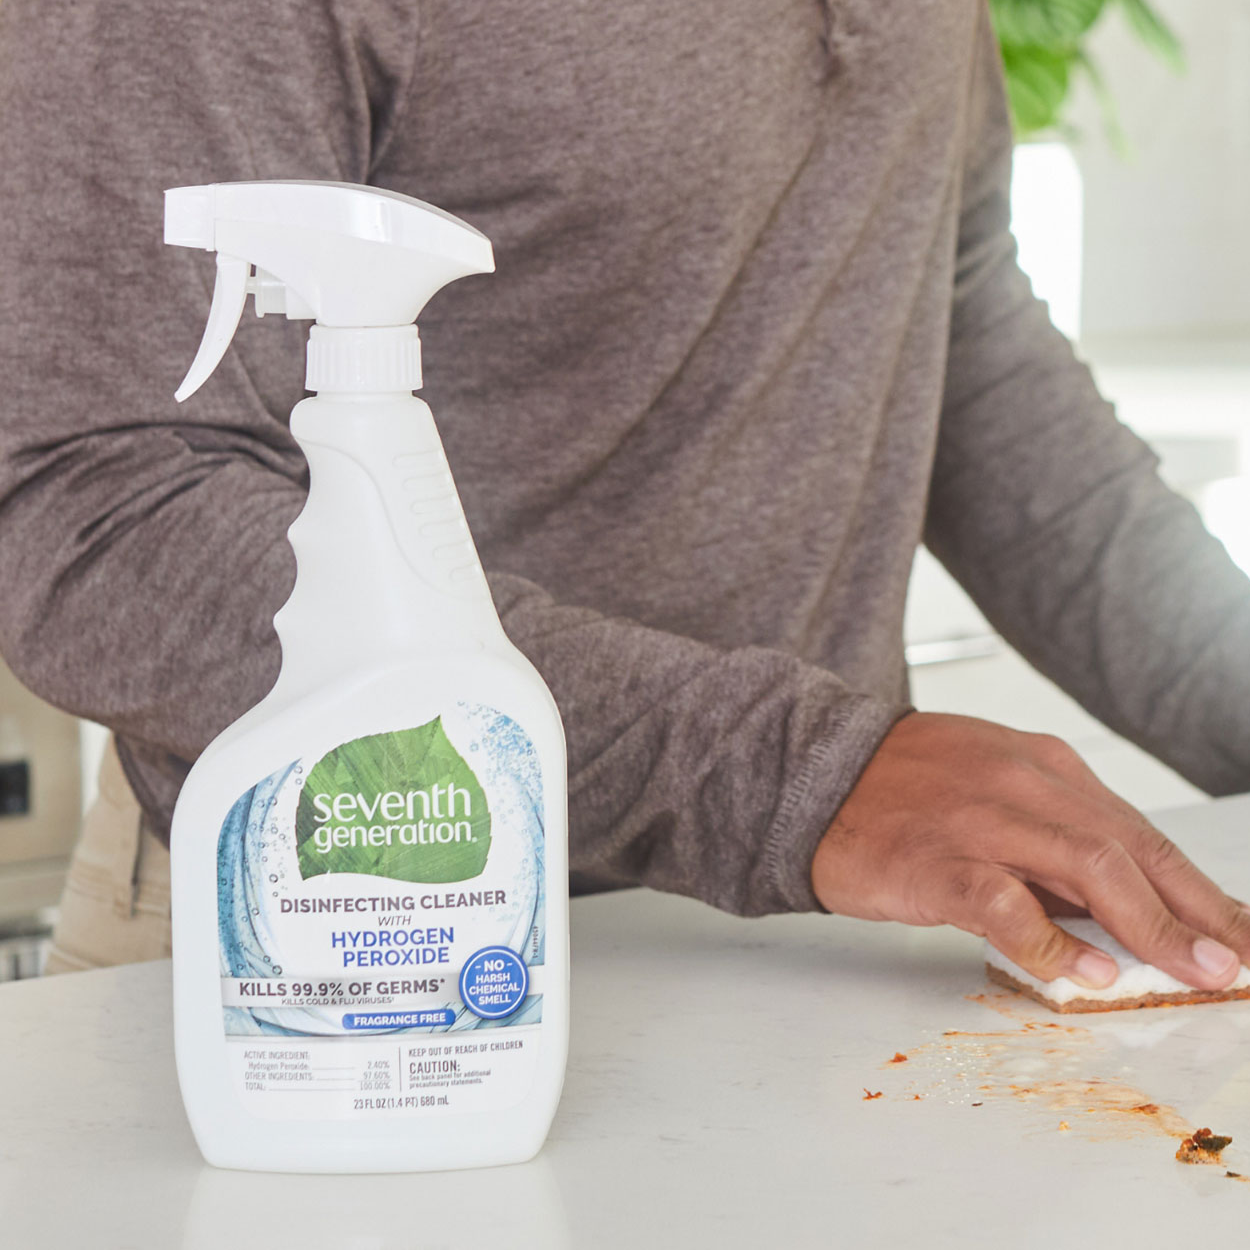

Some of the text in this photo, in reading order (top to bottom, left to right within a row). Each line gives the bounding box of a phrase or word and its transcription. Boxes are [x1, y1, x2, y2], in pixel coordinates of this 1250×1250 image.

[313, 782, 471, 822] seventh
[280, 890, 506, 913] DISINFECTING CLEANER
[378, 915, 412, 927] WITH
[331, 927, 454, 948] HYDROGEN
[343, 947, 450, 967] PEROXIDE
[476, 973, 511, 984] HARSH
[239, 982, 287, 996] KILLS
[292, 982, 344, 996] 99.9%
[348, 981, 372, 996] OF
[469, 982, 520, 995] CHEMICAL
[281, 998, 304, 1006] KILLS
[305, 998, 329, 1006] COLD
[339, 997, 355, 1005] FLU
[478, 993, 511, 1005] SMELL
[353, 1012, 446, 1026] FRAGRANCE FREE
[244, 1051, 267, 1059] ACTIVE
[408, 1039, 523, 1057] KEEP OUT OF REACH OF CHILDREN
[409, 1059, 460, 1075] CAUTION:
[353, 1098, 363, 1109] 23
[365, 1098, 374, 1108] FL
[420, 1095, 435, 1106] 680
[437, 1094, 449, 1105] mL
